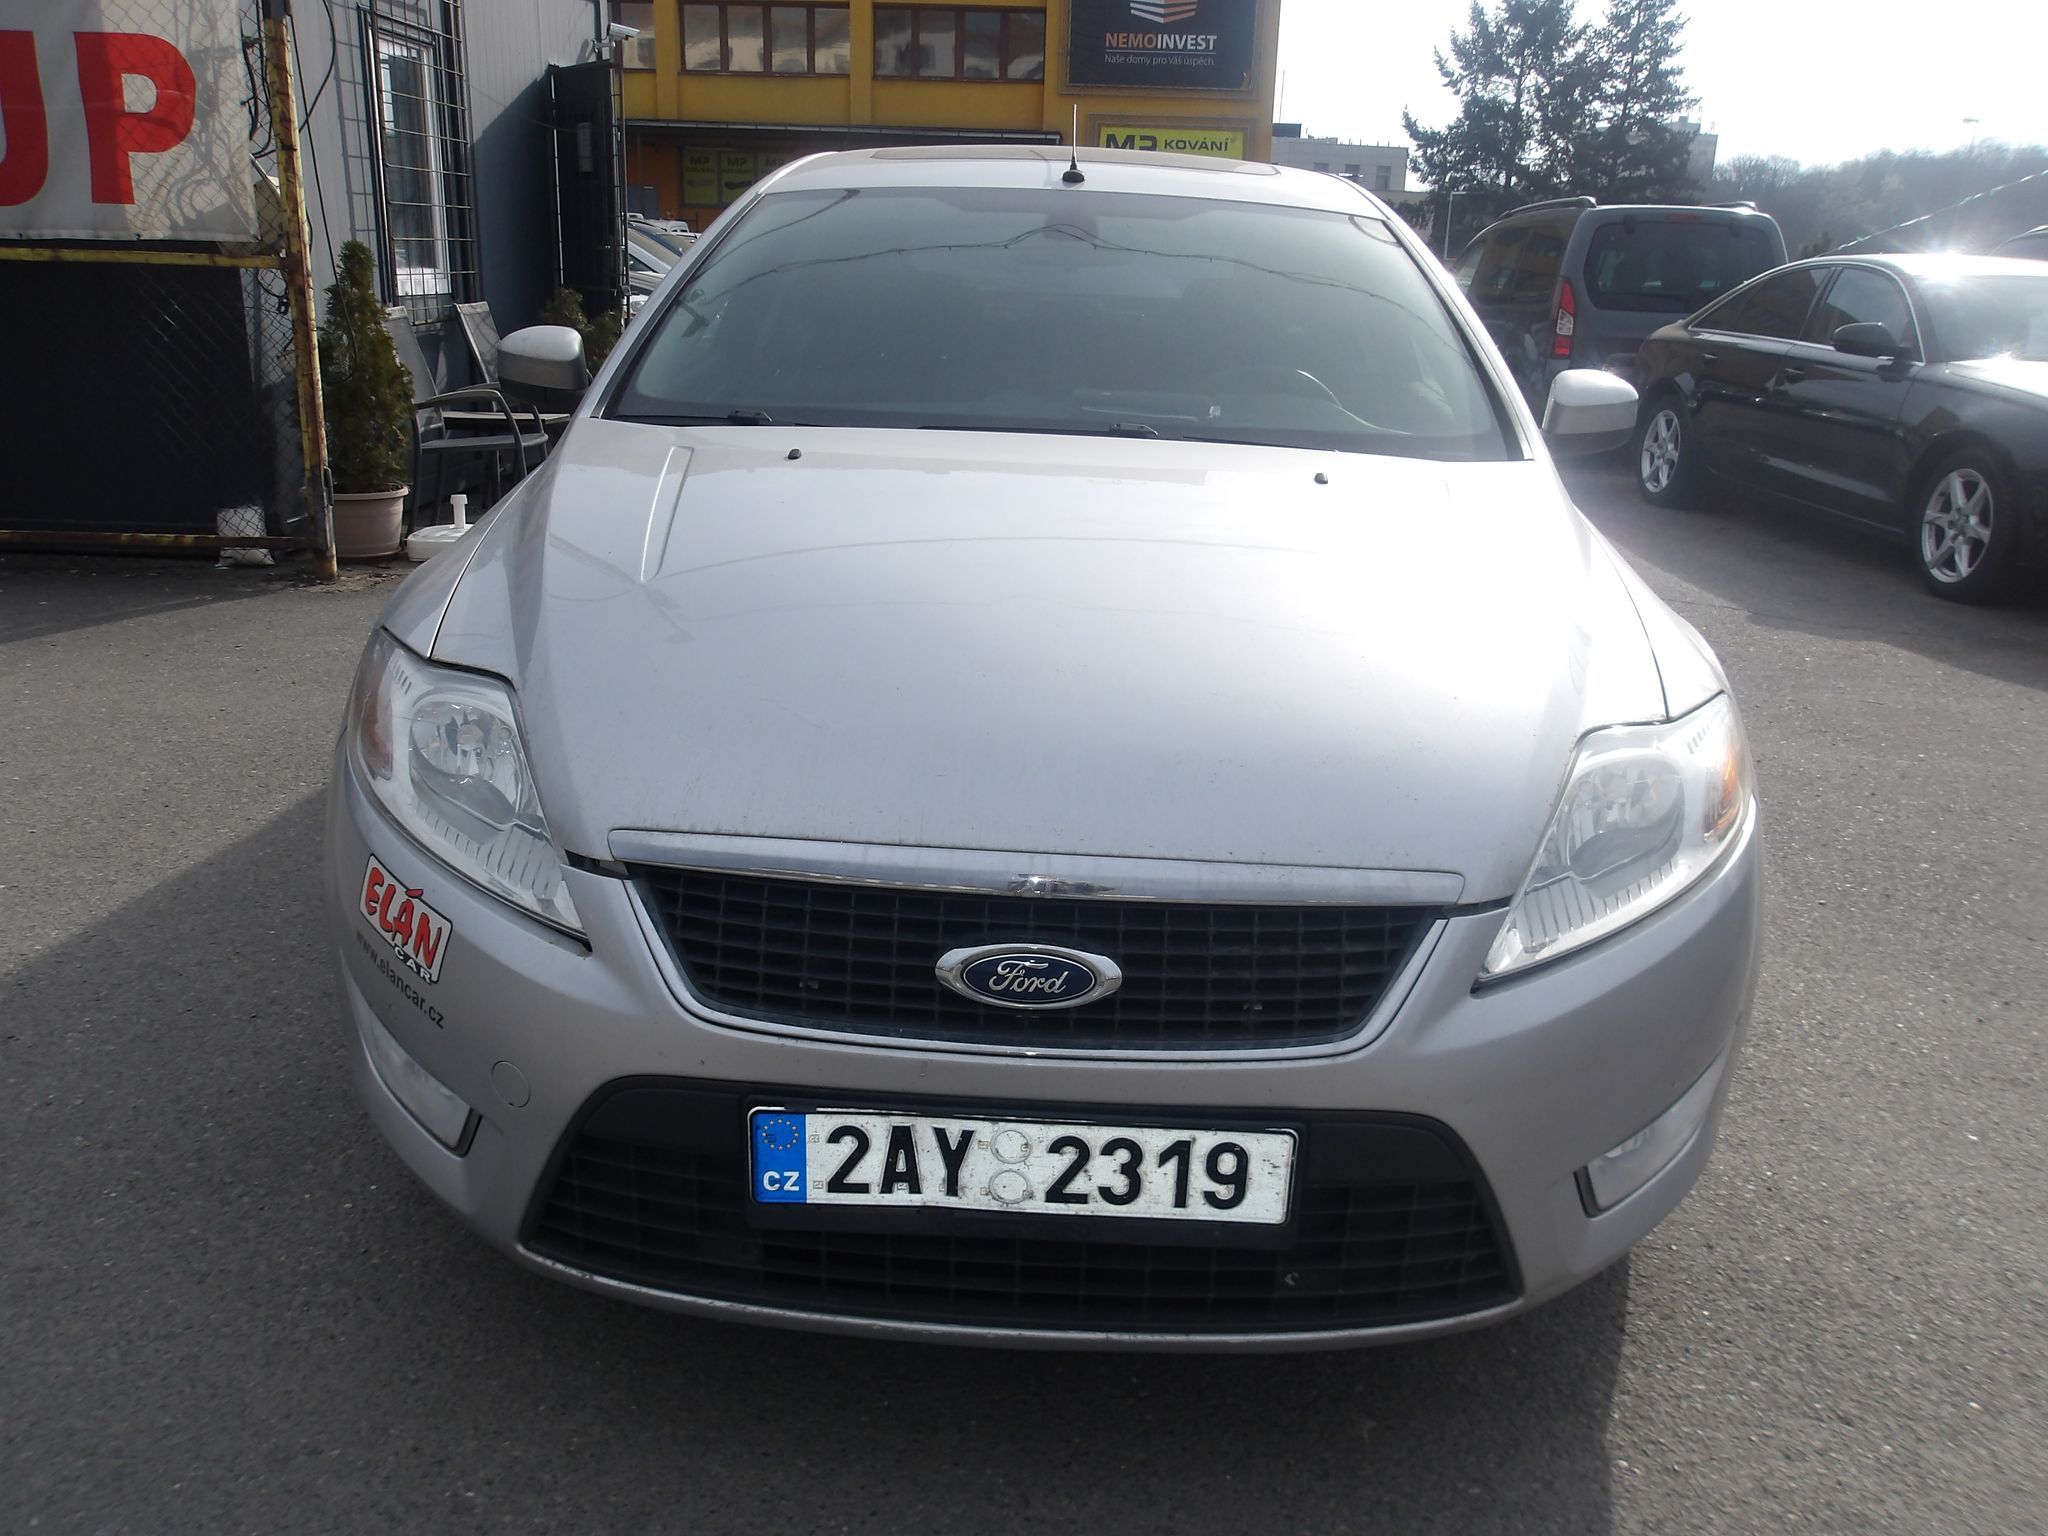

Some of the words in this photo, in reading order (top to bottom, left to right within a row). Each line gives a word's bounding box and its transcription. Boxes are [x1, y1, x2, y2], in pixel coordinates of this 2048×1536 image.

[1105, 33, 1217, 50] NEMOINVEST
[1105, 54, 1125, 64] Naše
[1126, 54, 1151, 66] domy
[1152, 56, 1168, 67] pro
[1168, 55, 1182, 65] Váš
[1164, 137, 1230, 151] KOVÁNÍ
[365, 866, 442, 970] ELÁN
[356, 928, 445, 1030] www.elancar.cz
[394, 946, 433, 985] CAR
[988, 959, 1070, 994] Ford
[763, 1171, 800, 1191] CZ
[827, 1124, 976, 1198] 2AY
[1045, 1134, 1249, 1210] 2319
